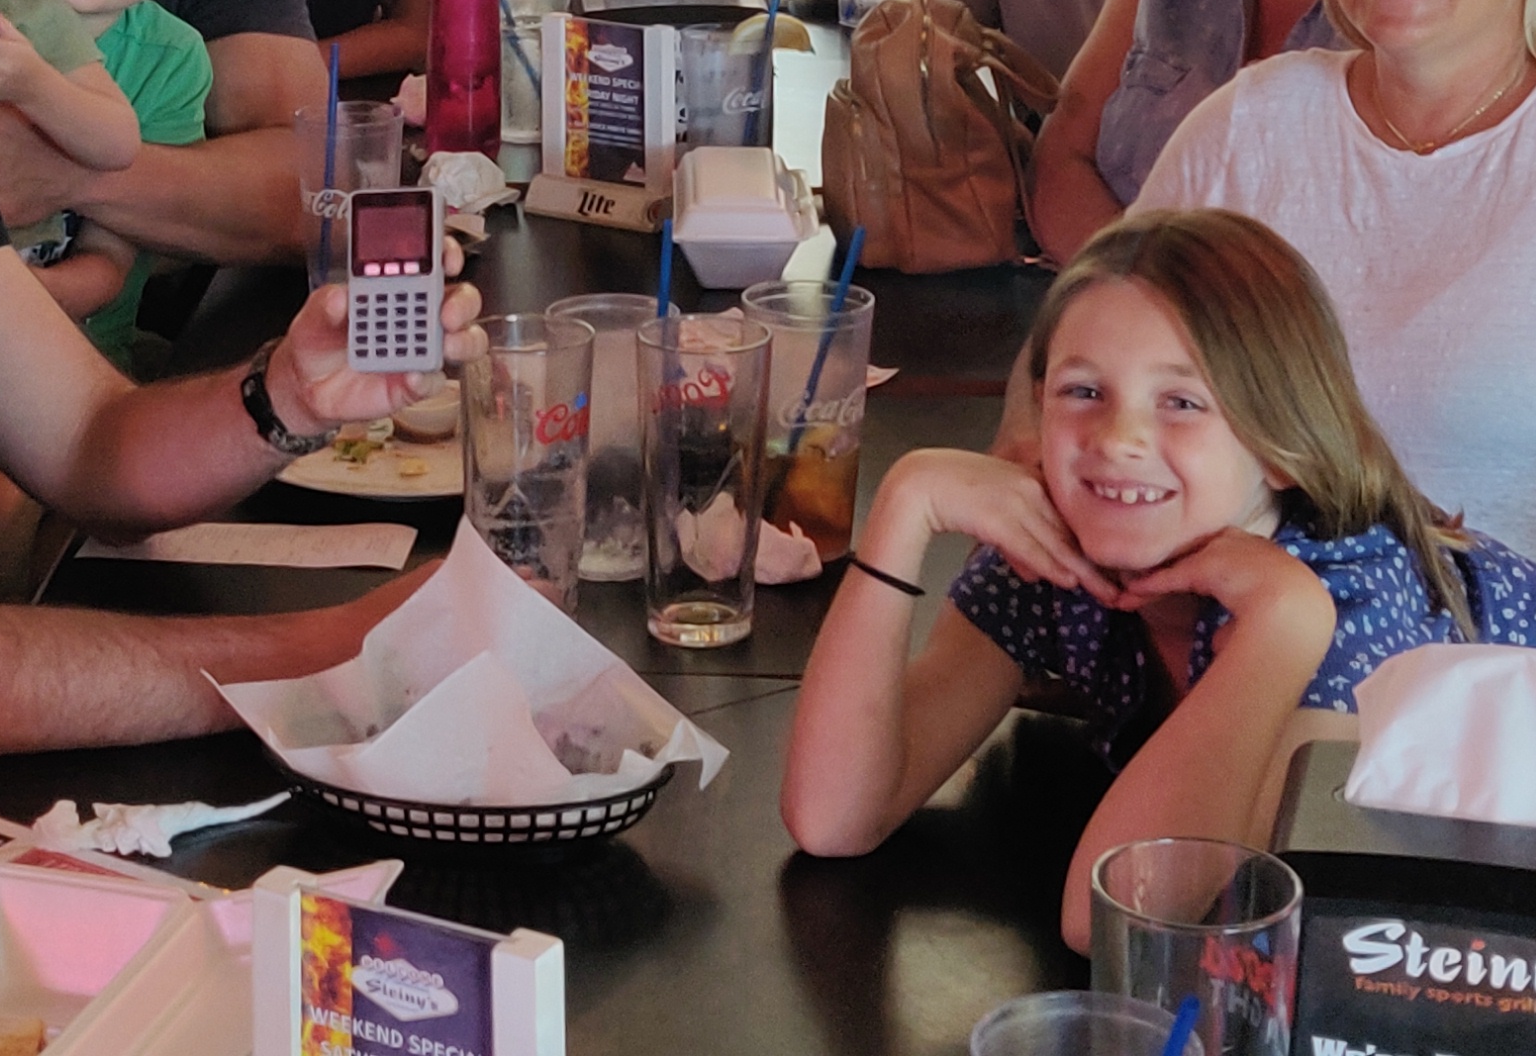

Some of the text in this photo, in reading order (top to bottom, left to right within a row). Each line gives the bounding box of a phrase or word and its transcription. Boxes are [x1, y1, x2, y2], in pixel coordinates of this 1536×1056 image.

[577, 191, 616, 217] Lite
[365, 978, 440, 1011] Steiny's
[1426, 986, 1493, 1008] sports
[310, 1006, 404, 1049] WEEKEND
